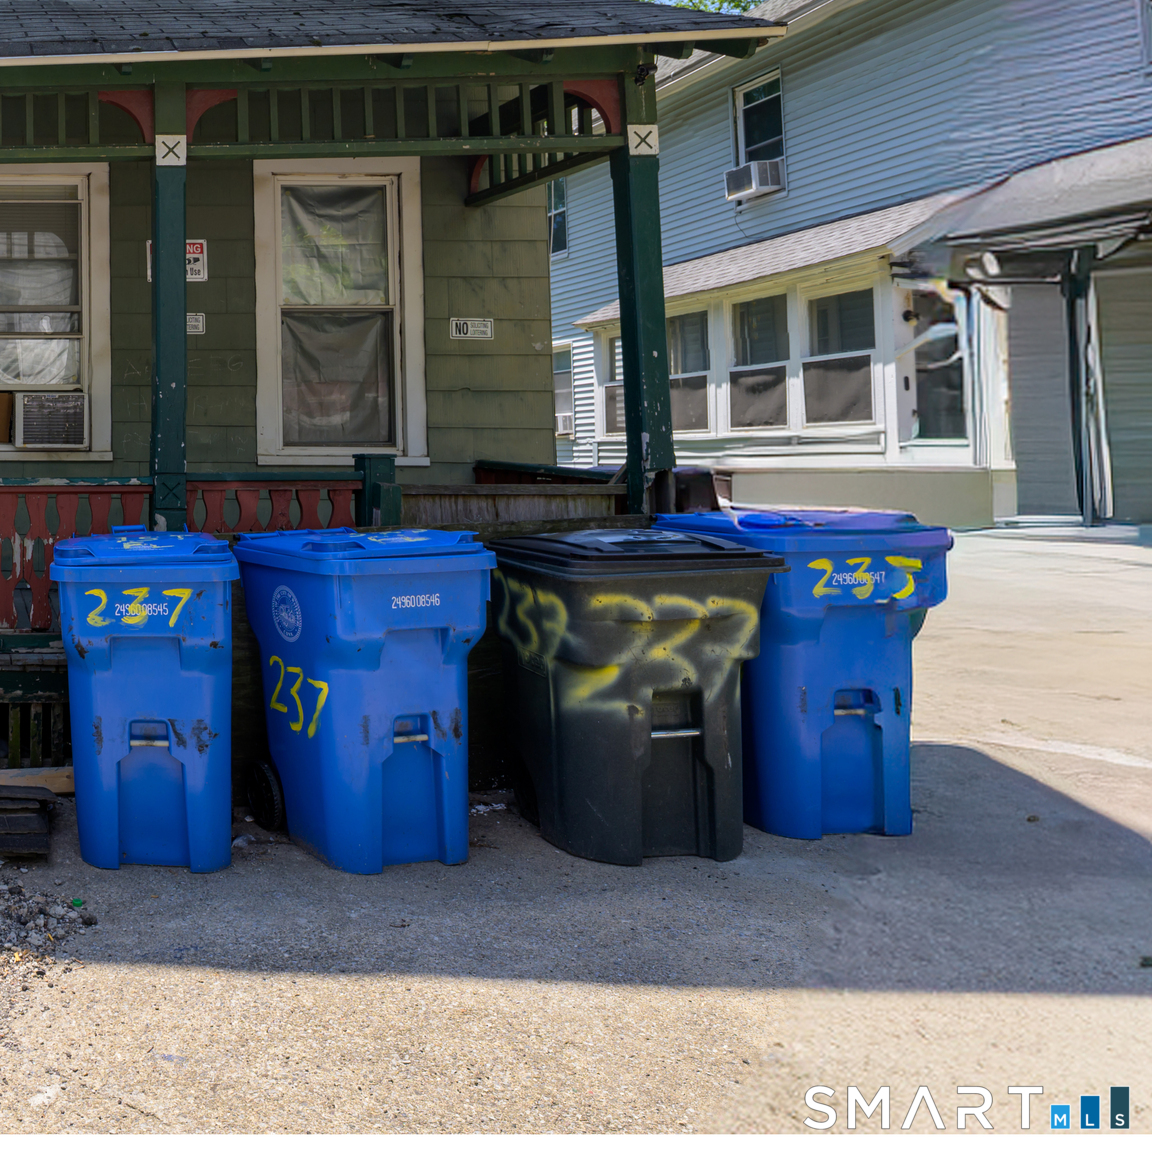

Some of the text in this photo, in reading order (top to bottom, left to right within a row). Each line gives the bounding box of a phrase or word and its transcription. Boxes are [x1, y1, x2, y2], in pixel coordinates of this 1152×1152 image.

[189, 267, 201, 276] Use
[455, 322, 468, 335] NO
[84, 587, 194, 628] 237
[269, 655, 330, 739] 237
